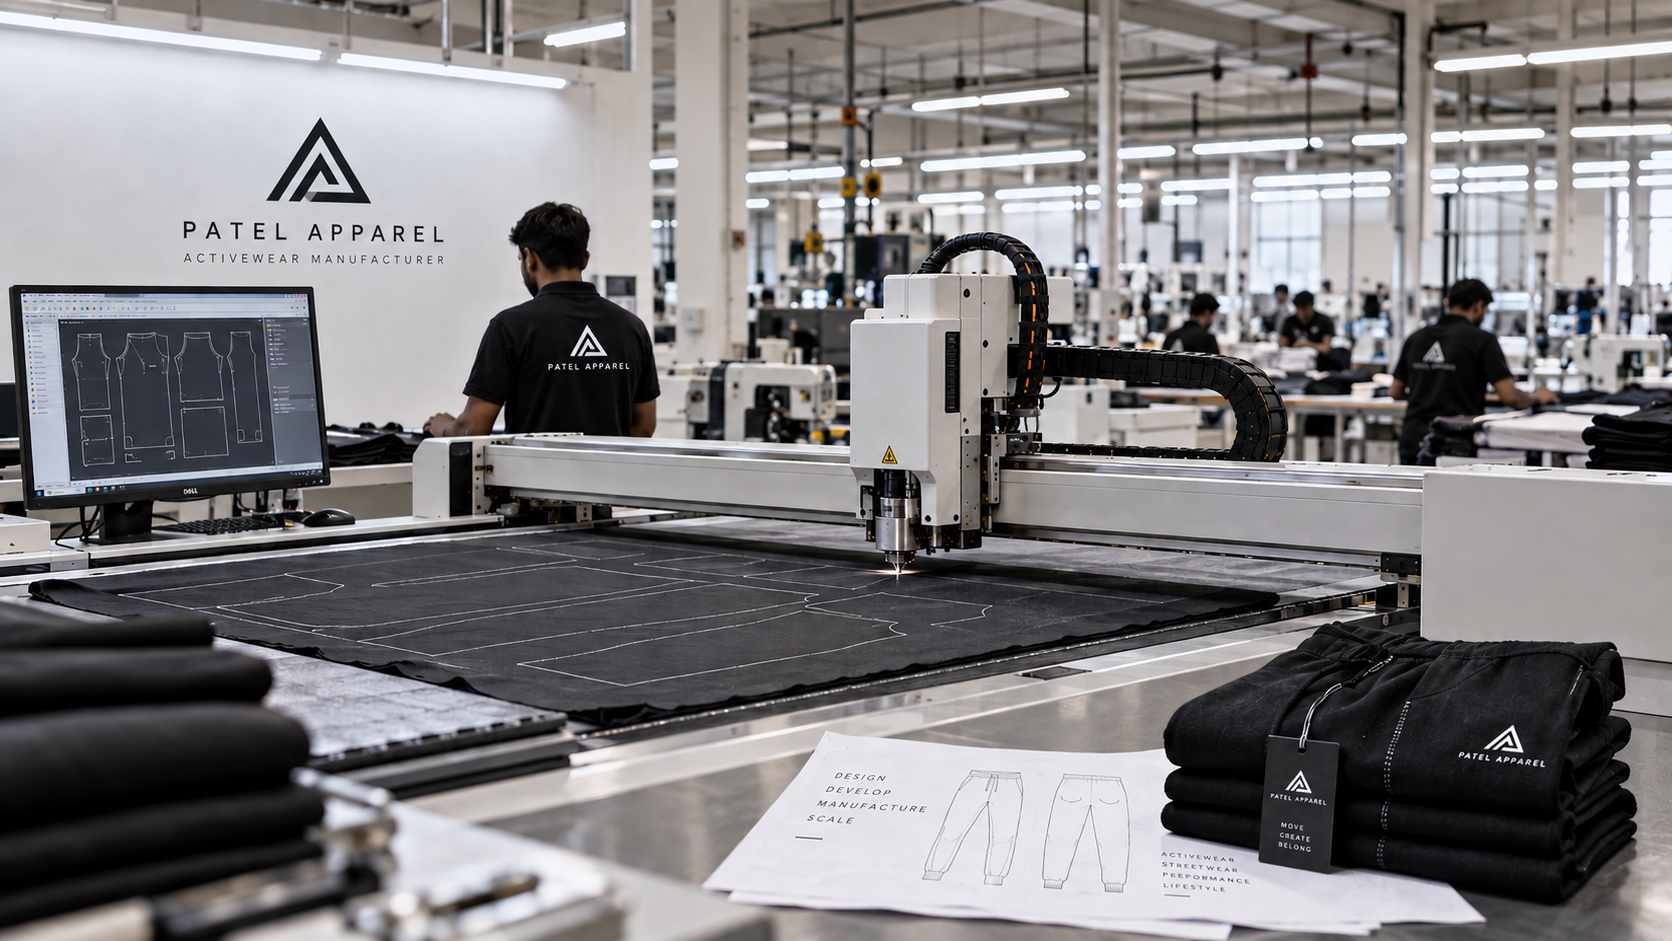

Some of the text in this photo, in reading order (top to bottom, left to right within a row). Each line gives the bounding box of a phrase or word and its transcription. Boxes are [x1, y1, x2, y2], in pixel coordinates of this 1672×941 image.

[183, 220, 444, 243] PATEL APPAREL
[183, 252, 444, 265] ACTIVEWEAR MANUFACTURER
[547, 362, 630, 371] PATEL APPAREL
[1458, 751, 1546, 768] PATEL APPAREL
[834, 772, 887, 782] DESIGN
[825, 786, 892, 796] DEVELOP
[1270, 793, 1327, 806] PATEL APPAREL
[816, 800, 928, 813] MANUFACTURE
[806, 814, 855, 825] SCALE
[1280, 822, 1304, 831] MOVE
[1279, 832, 1311, 843] CREATE
[1278, 841, 1312, 853] BELONG
[1161, 851, 1235, 863] ACTIVEWEAR
[1162, 861, 1238, 873] STREETWEAR
